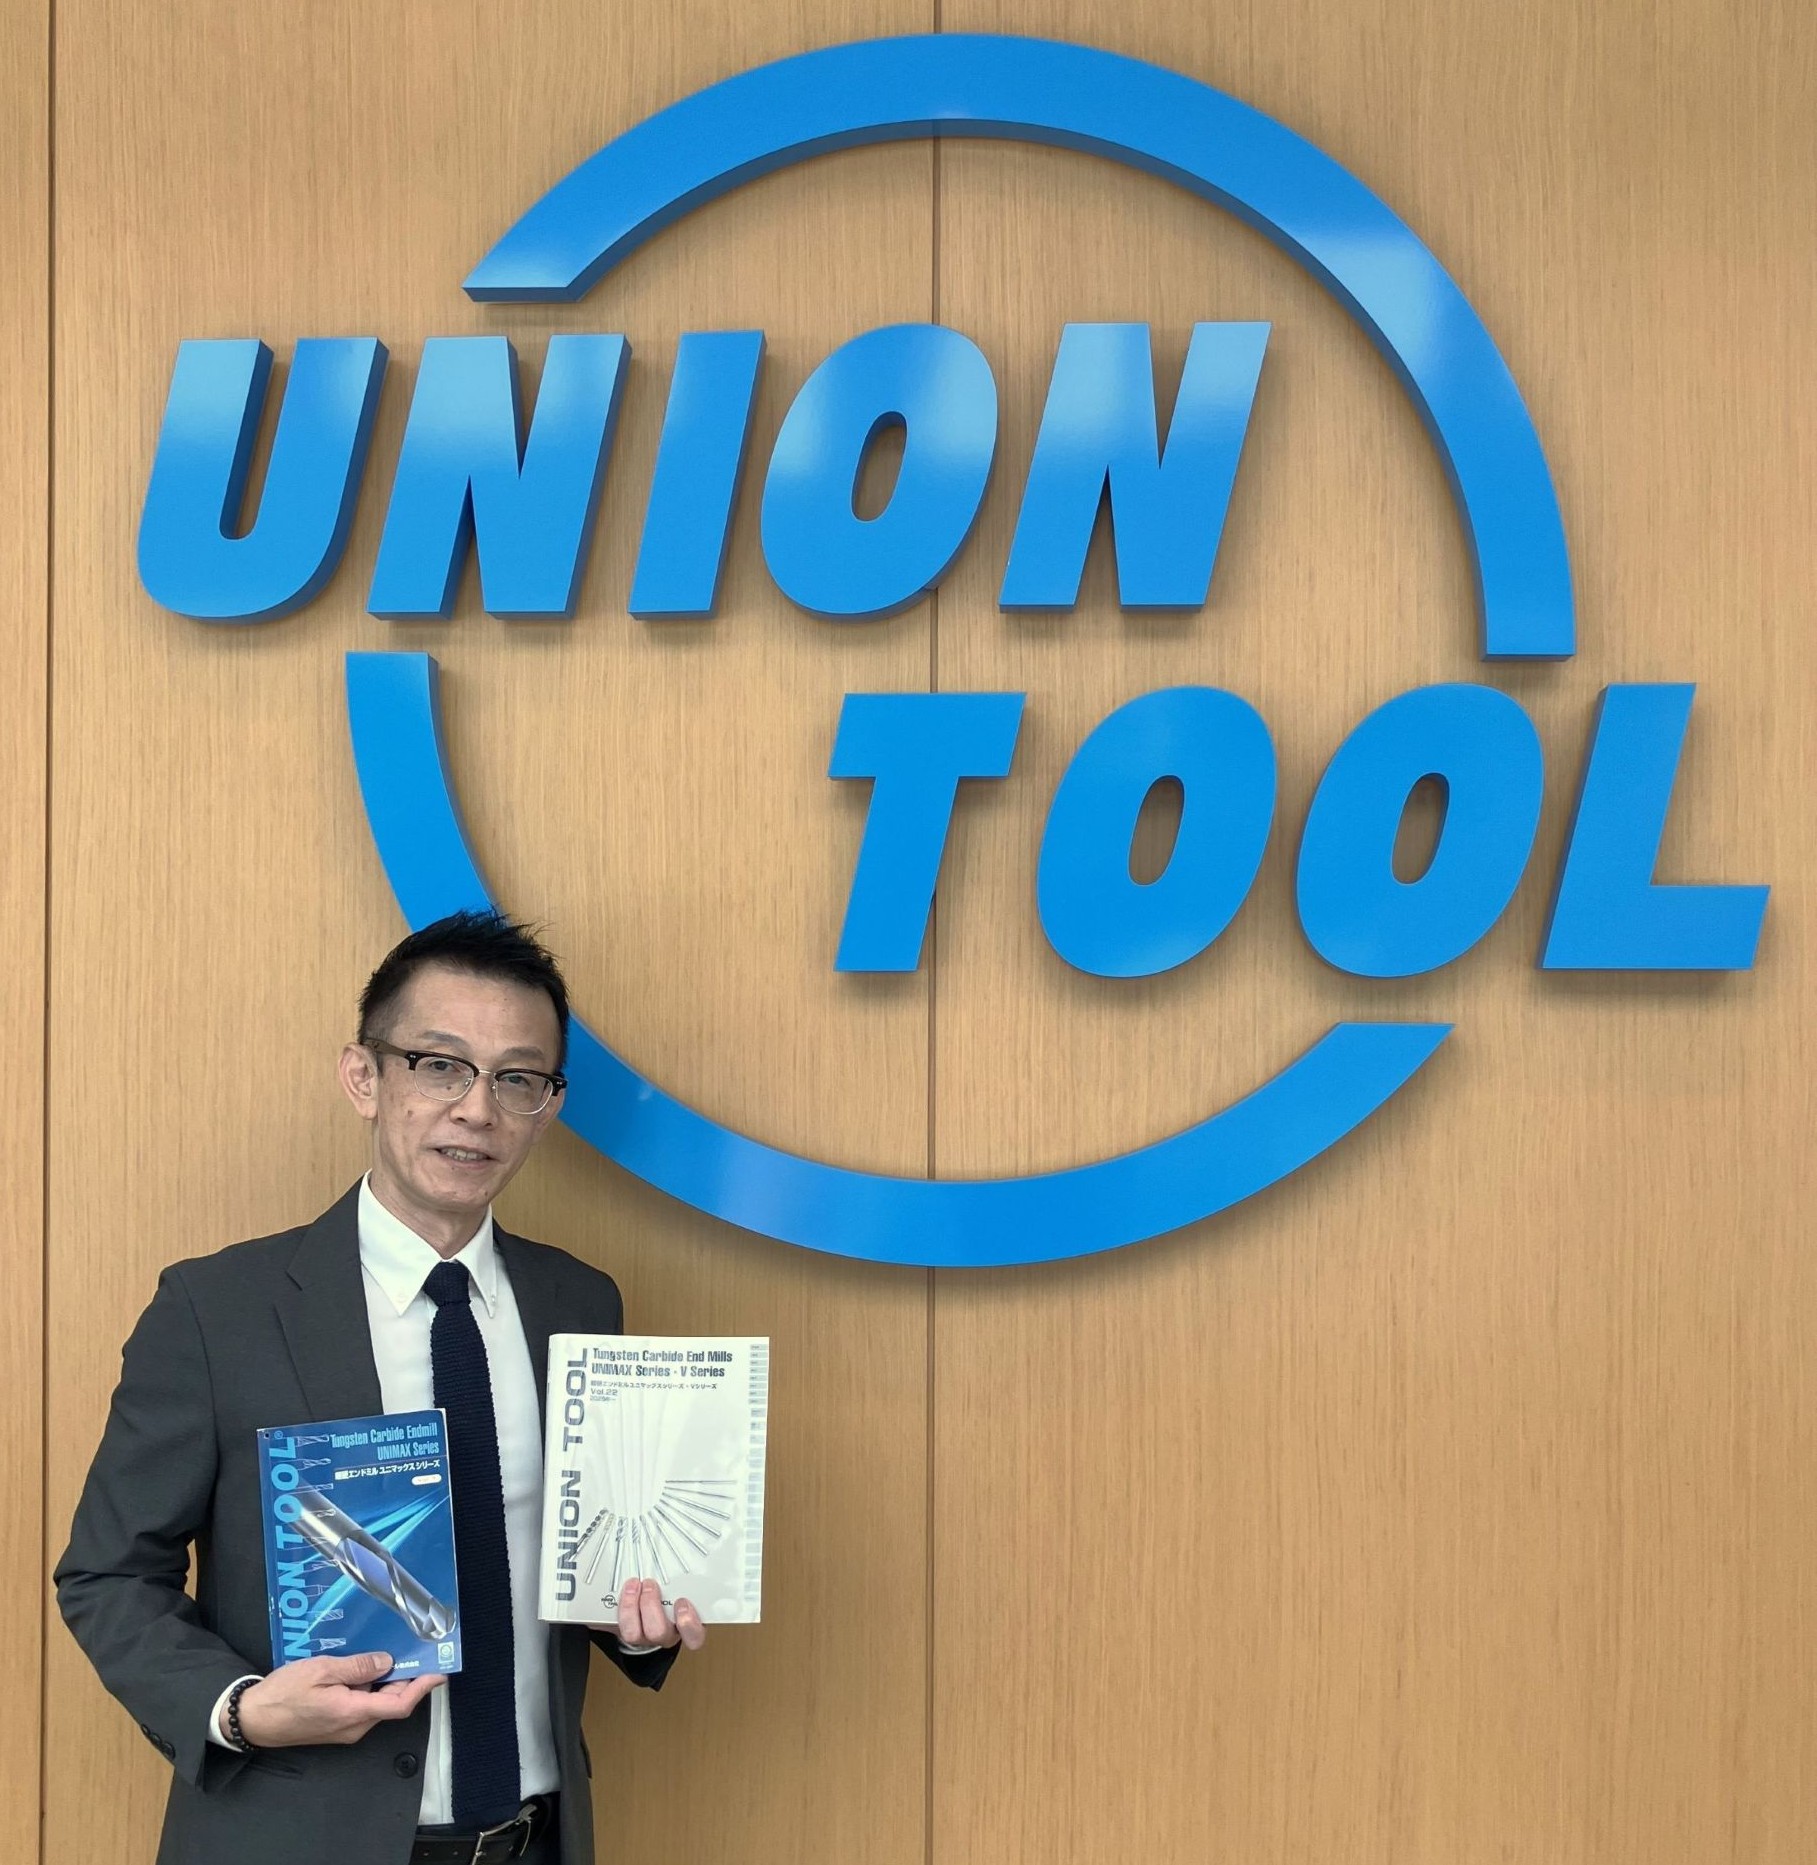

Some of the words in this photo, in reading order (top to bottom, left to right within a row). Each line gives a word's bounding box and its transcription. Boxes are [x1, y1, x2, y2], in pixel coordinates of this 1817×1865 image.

[137, 320, 1272, 621] UNION
[828, 681, 1771, 979] TOOL
[561, 1348, 588, 1452] TOOL
[591, 1363, 632, 1376] UNIMAX
[635, 1365, 671, 1377] Series
[680, 1366, 688, 1377] V
[690, 1366, 725, 1378] Series
[593, 1348, 639, 1361] Tungsten
[642, 1350, 683, 1362] Carbide
[686, 1351, 705, 1362] End
[707, 1351, 733, 1363] Mills
[330, 1431, 368, 1448] Tungsten
[370, 1426, 405, 1443] Carbide
[406, 1422, 438, 1439] Endmill
[377, 1443, 411, 1460] UNIMAX
[413, 1441, 439, 1456] Series
[269, 1437, 304, 1549] TOOL
[555, 1470, 581, 1601] UNION
[277, 1561, 312, 1664] NION
